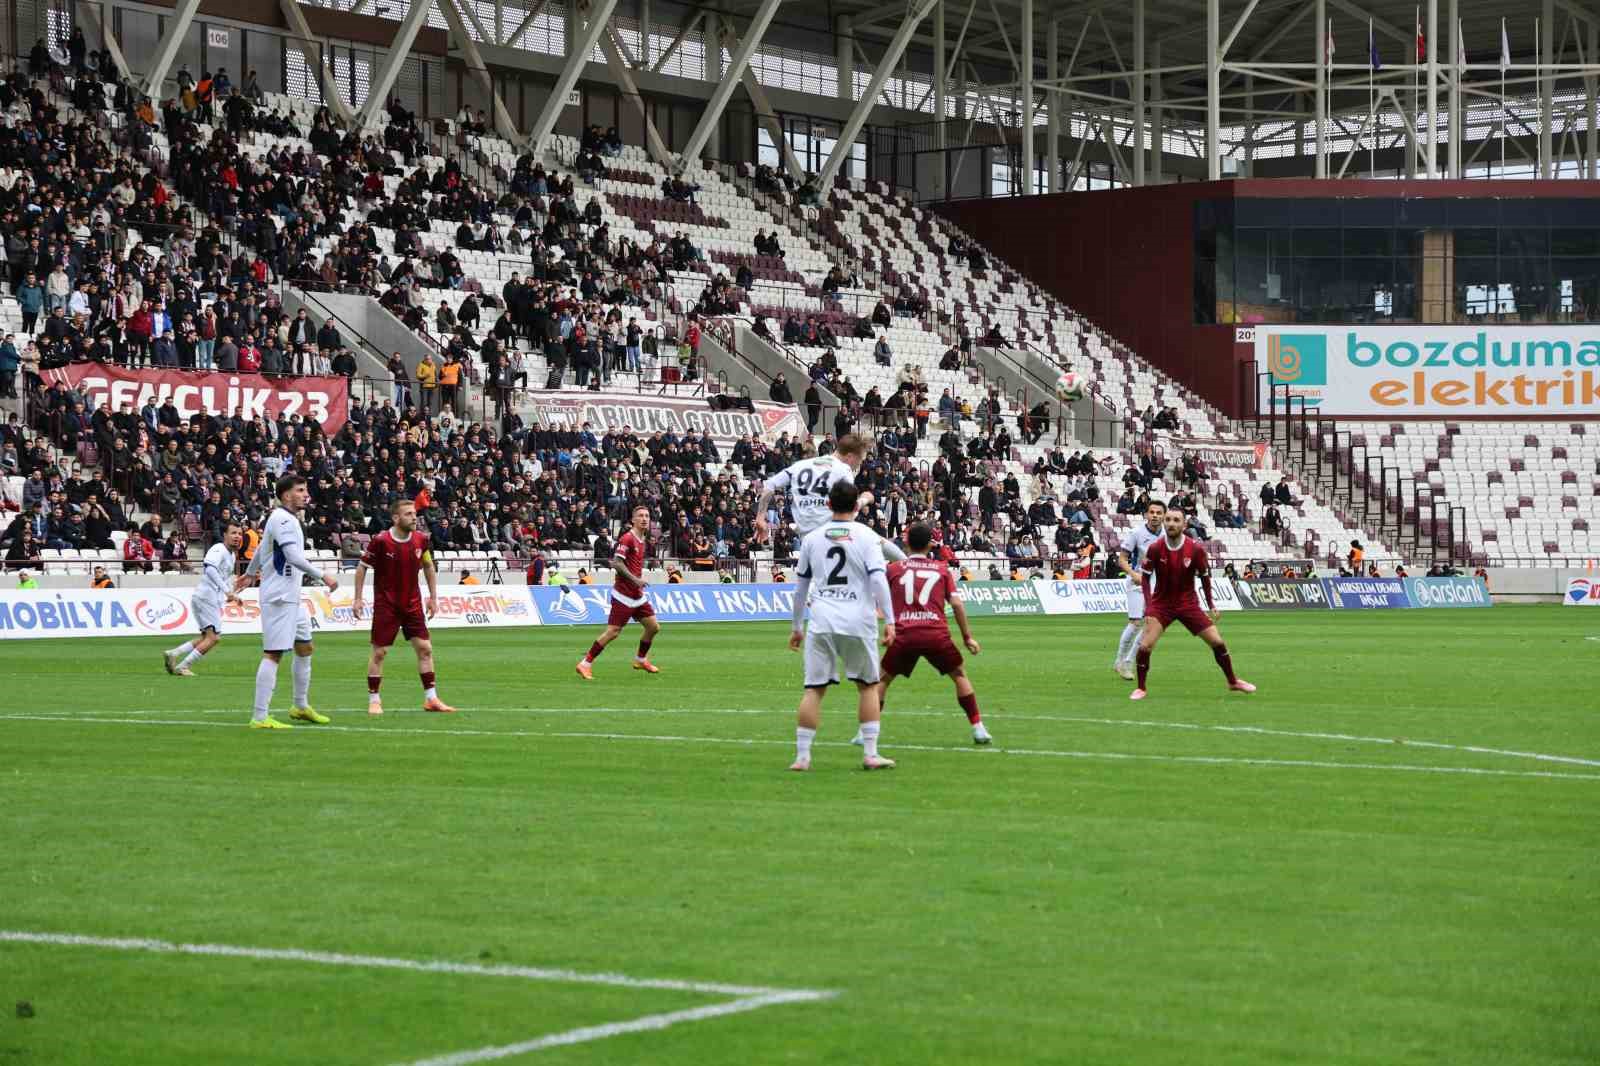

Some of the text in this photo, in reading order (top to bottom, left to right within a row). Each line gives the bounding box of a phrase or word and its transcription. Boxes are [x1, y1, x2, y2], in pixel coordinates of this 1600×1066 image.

[210, 32, 227, 45] 106
[277, 391, 330, 425] 23
[683, 411, 767, 437] GRUBU
[798, 468, 831, 495] 94
[826, 546, 848, 585] 2
[899, 569, 940, 606] 17
[1075, 582, 1127, 596] HYUNDAI
